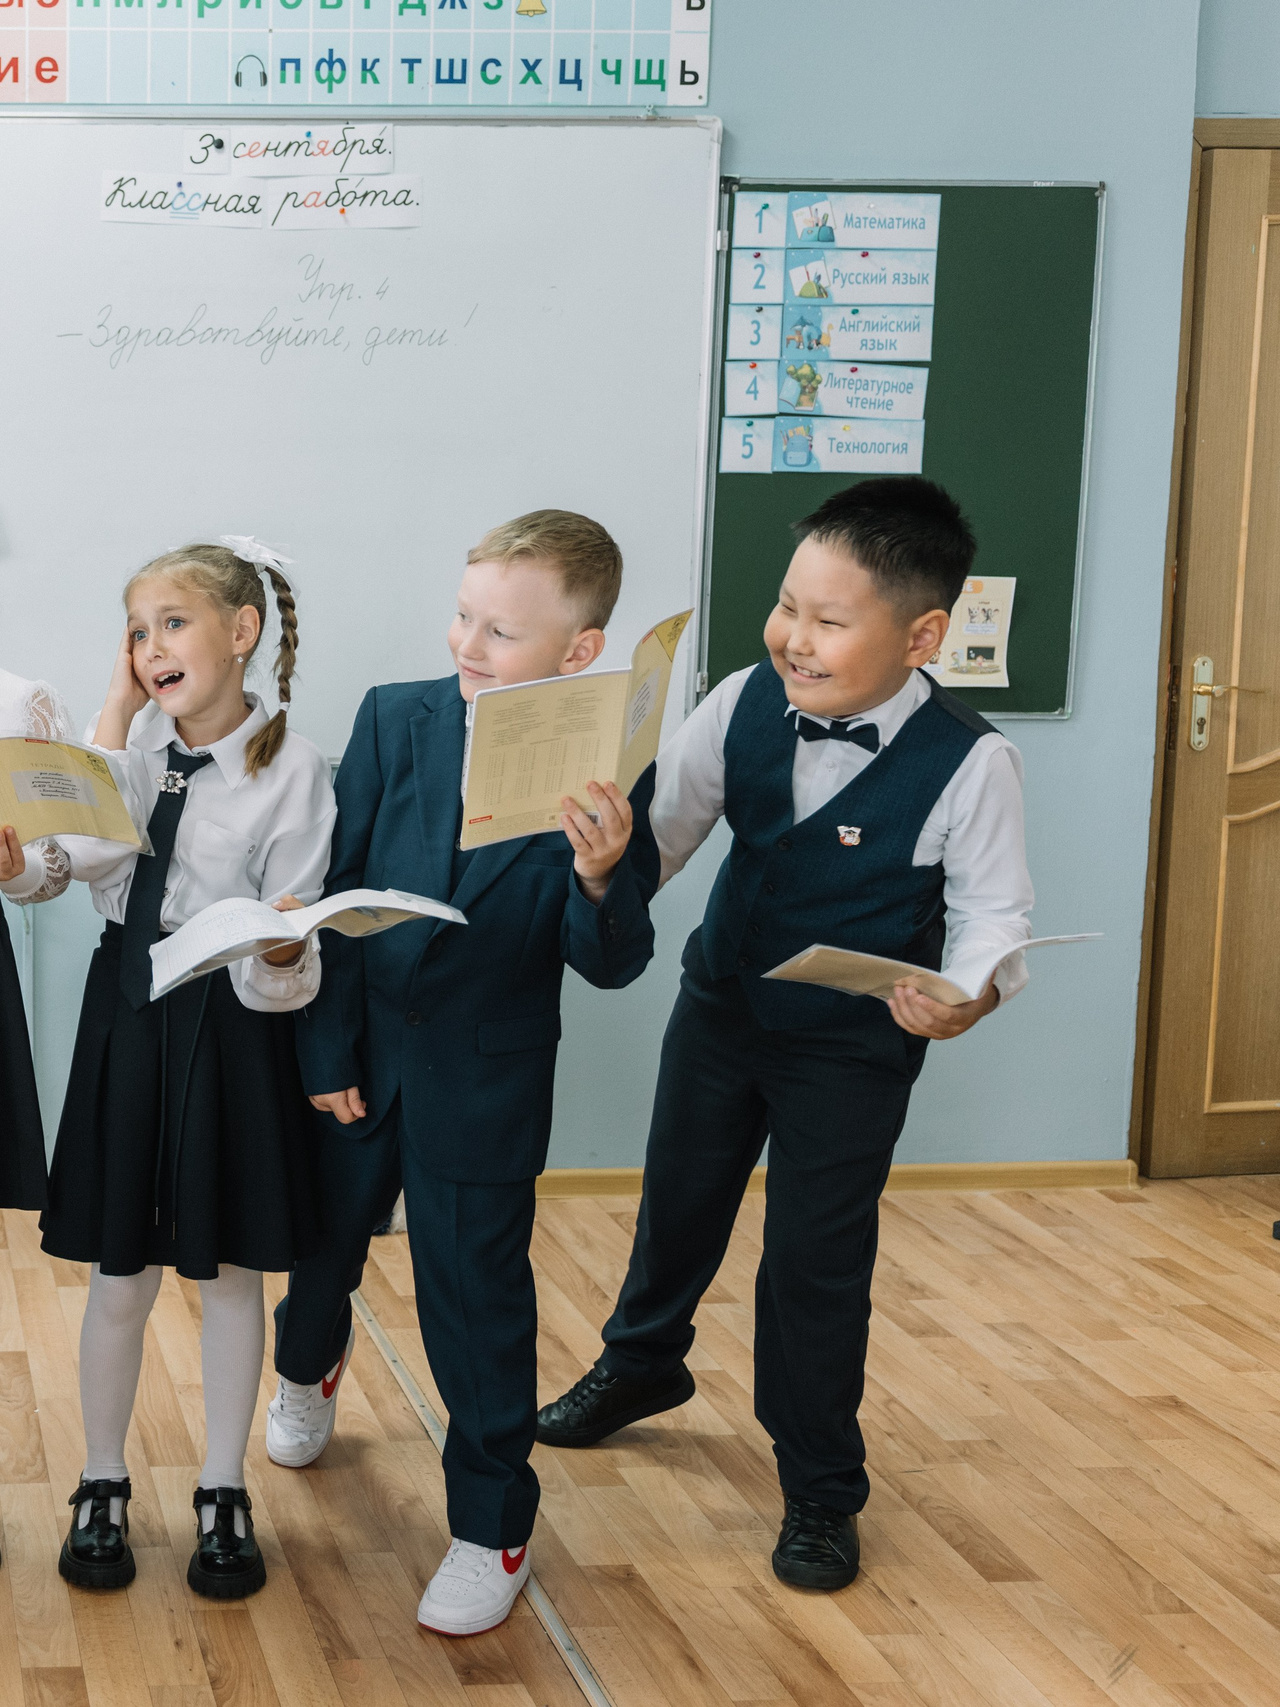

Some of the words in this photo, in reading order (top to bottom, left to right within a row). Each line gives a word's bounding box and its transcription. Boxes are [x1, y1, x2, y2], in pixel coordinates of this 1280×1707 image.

[190, 133, 210, 164] 3
[105, 177, 262, 215] Классная
[755, 209, 764, 234] 1
[843, 213, 926, 230] Математика
[375, 277, 391, 301] 4
[753, 264, 766, 290] 2
[832, 267, 887, 288] Русский
[892, 271, 930, 285] язык
[750, 319, 761, 346] 3
[838, 315, 921, 333] Английский
[860, 338, 898, 351] язык
[745, 375, 759, 401] 4
[824, 372, 914, 396] Литературное
[846, 395, 894, 411] чтение
[741, 434, 754, 459] 5
[827, 437, 909, 454] Технология
